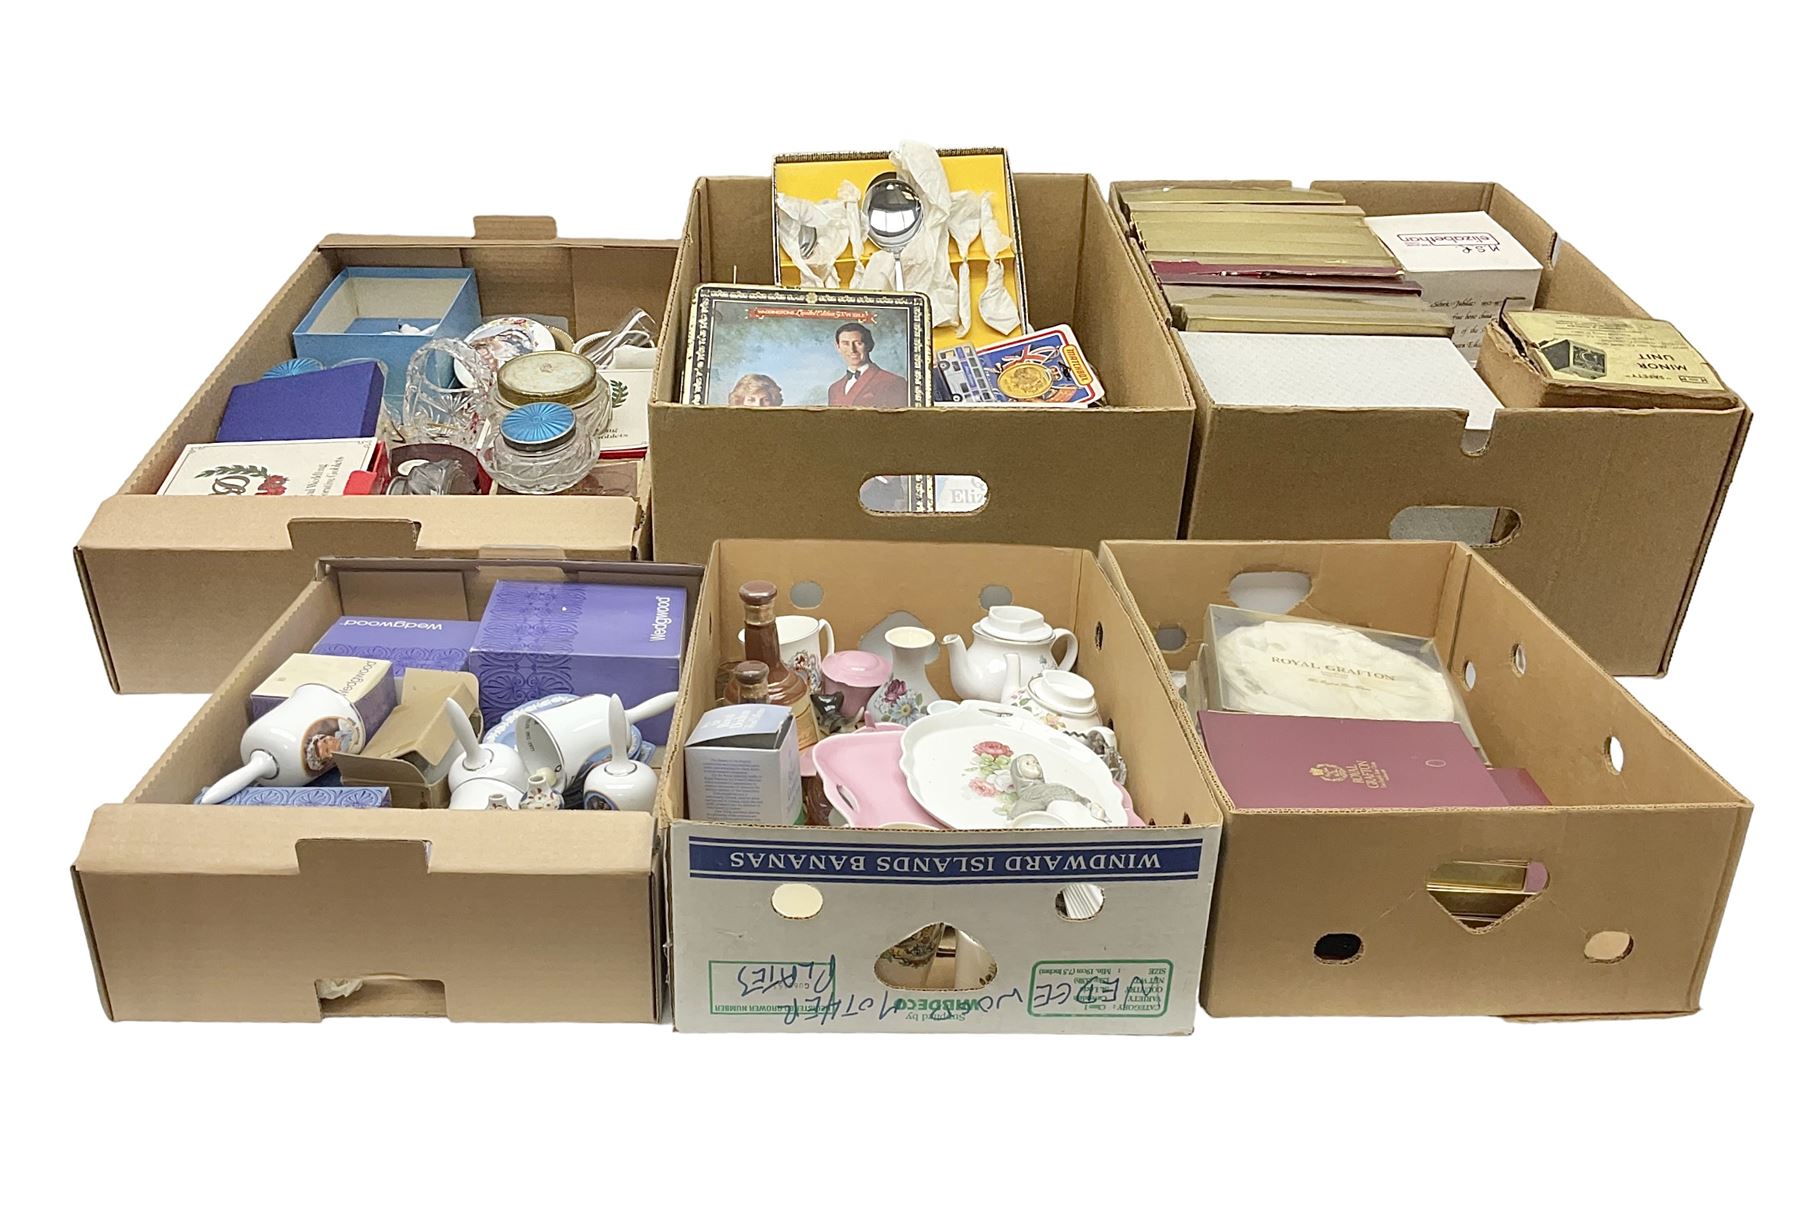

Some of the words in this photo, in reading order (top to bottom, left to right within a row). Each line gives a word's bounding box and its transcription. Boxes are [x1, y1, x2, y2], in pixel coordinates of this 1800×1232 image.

[1638, 353, 1675, 361] UNIT
[1636, 362, 1688, 372] MINOR
[343, 619, 443, 631] Wedgwood
[649, 596, 672, 642] Wedgwood
[1271, 656, 1321, 670] ROYAL
[1324, 665, 1395, 681] GRAFTON
[730, 852, 866, 871] BANANAS
[876, 856, 994, 872] ISLANDS
[1004, 853, 1161, 871] WINDWARD
[1149, 967, 1166, 975] SIZE
[715, 1004, 747, 1012] NUMBER
[905, 1012, 919, 1022] by
